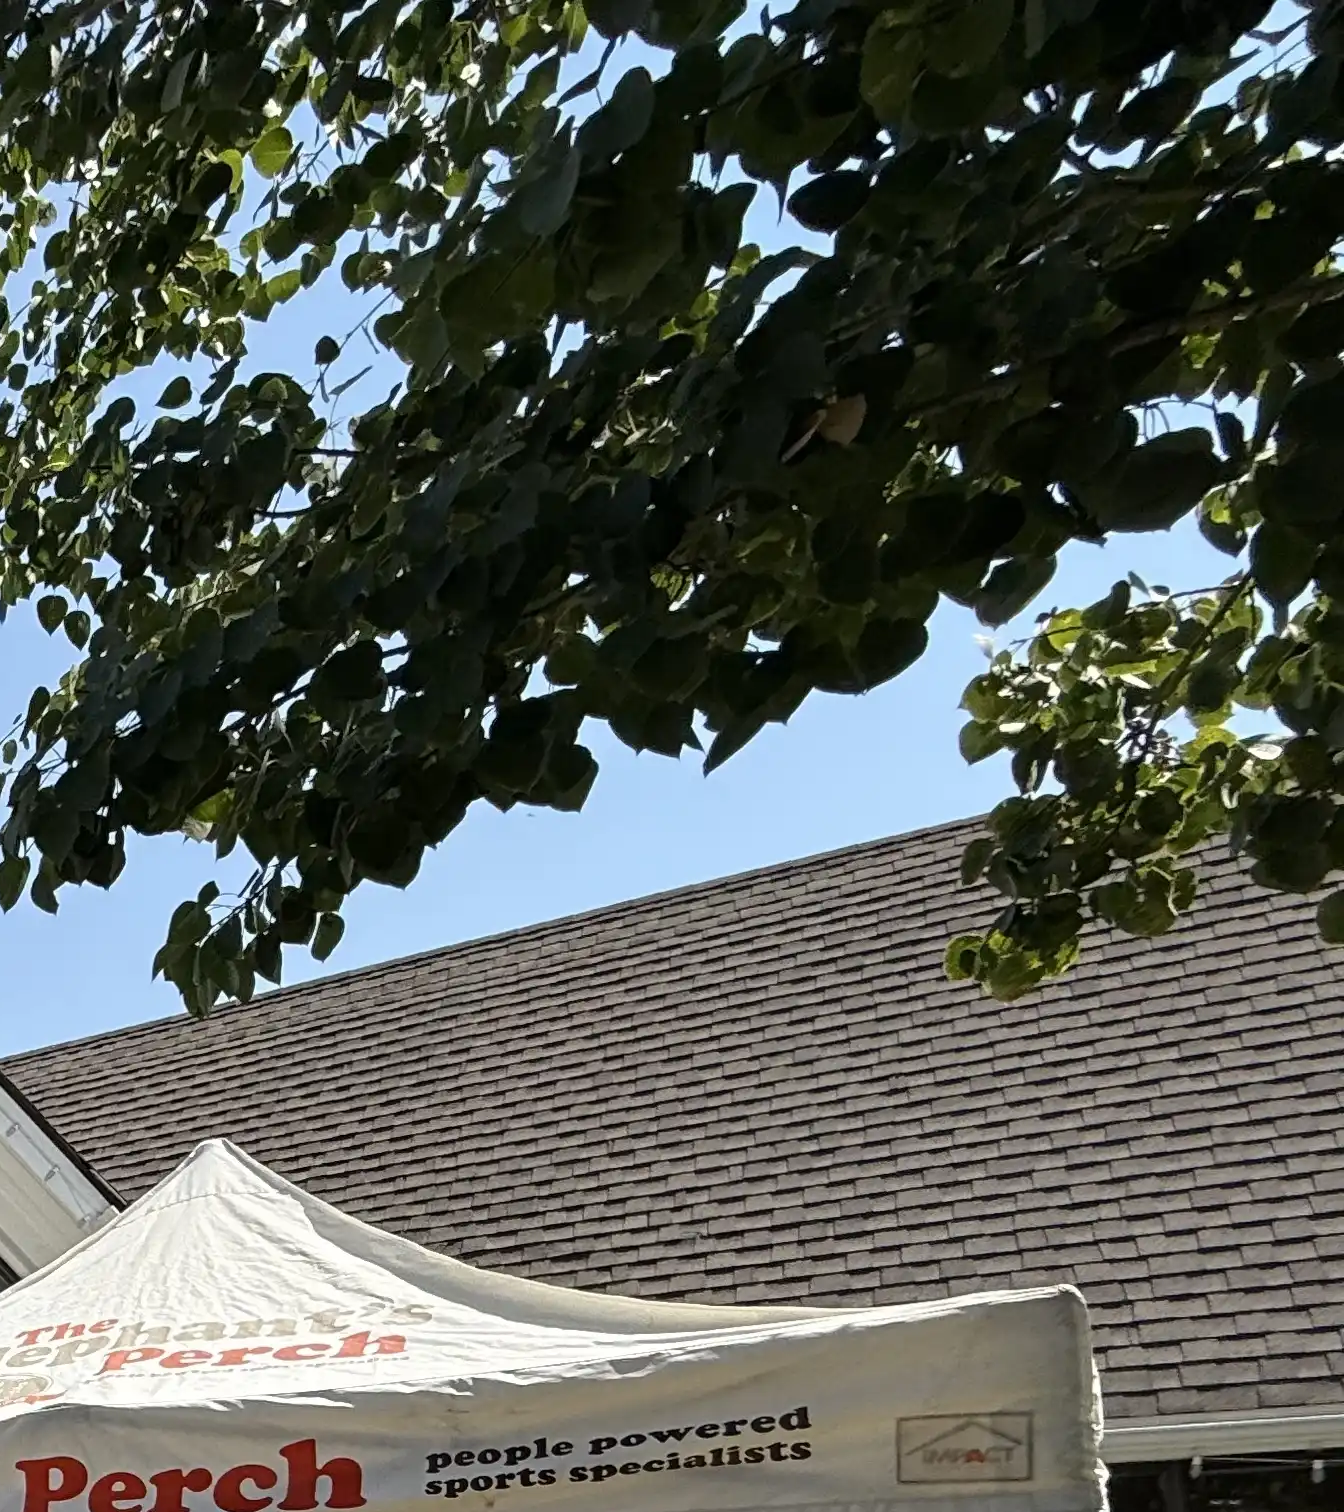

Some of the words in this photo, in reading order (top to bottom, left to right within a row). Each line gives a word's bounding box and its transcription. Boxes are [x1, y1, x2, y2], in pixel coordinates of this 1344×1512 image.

[15, 1318, 119, 1348] The
[93, 1330, 407, 1376] Perch
[425, 1437, 574, 1474] people
[588, 1406, 812, 1455] powered
[922, 1446, 1016, 1464] IMPACT
[424, 1466, 557, 1498] sports
[568, 1439, 812, 1483] specialists
